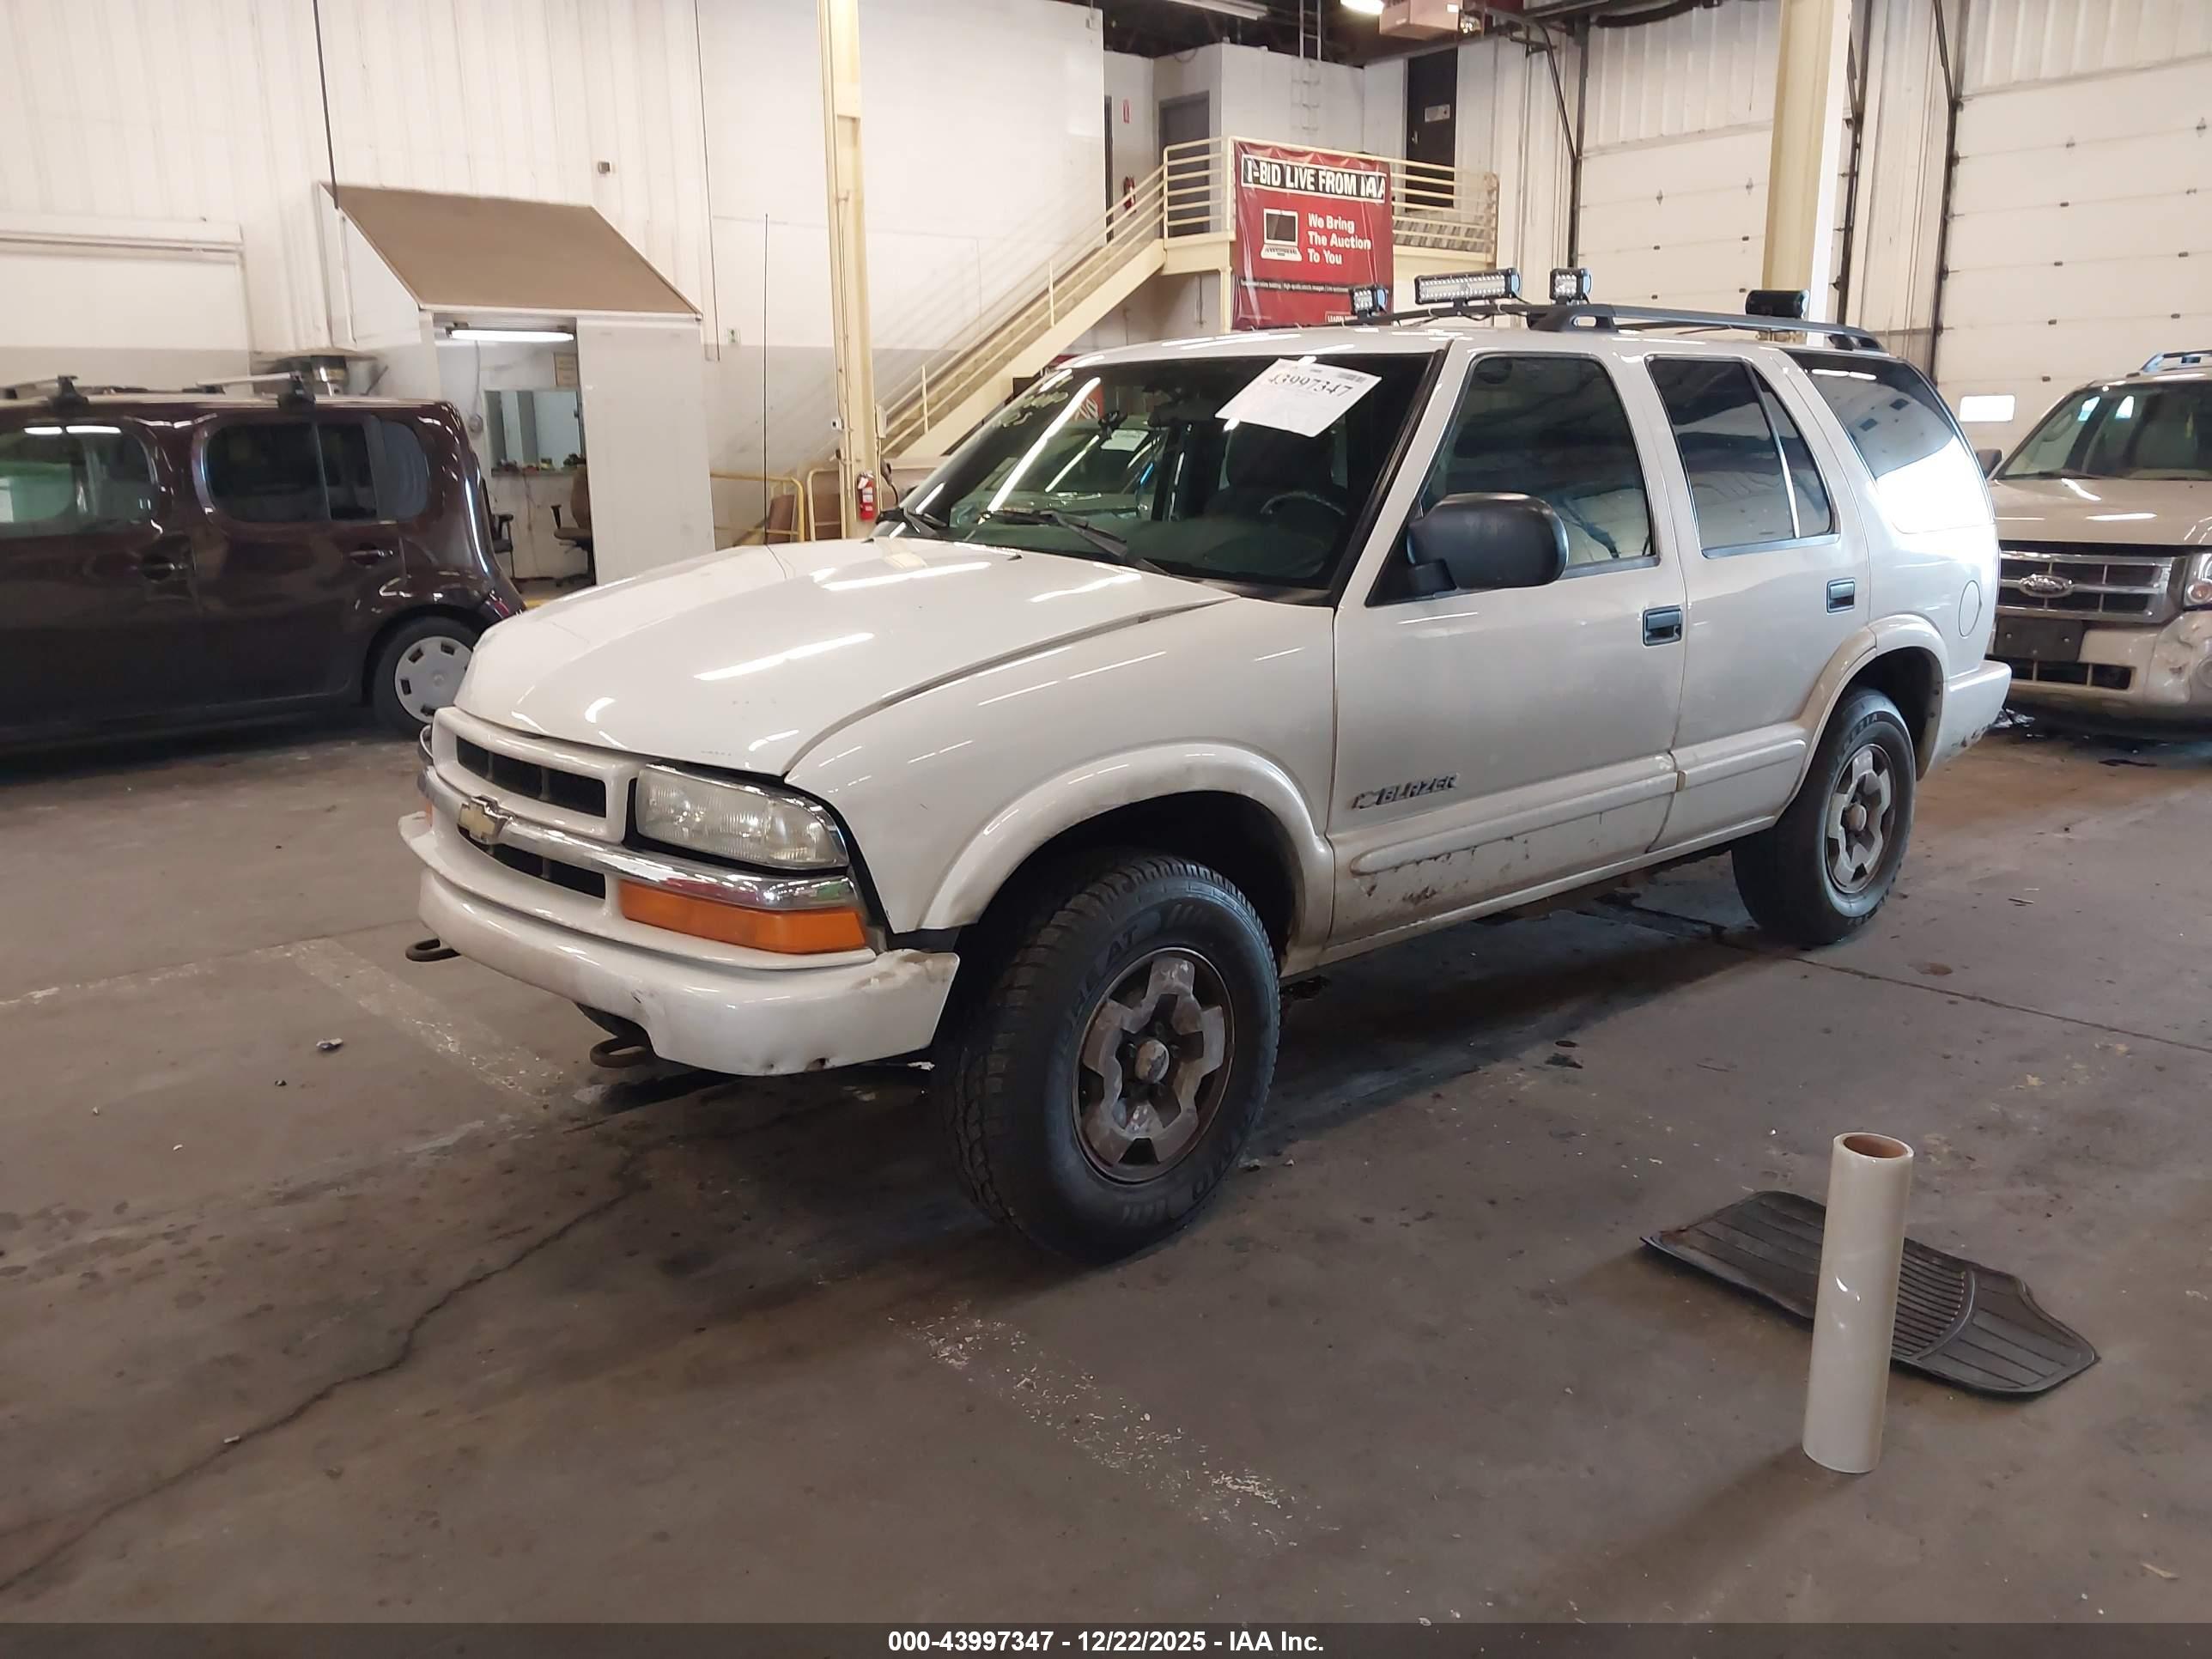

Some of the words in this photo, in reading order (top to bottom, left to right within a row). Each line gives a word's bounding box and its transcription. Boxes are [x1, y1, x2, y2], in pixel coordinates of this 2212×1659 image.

[1247, 160, 1281, 186] I-BID
[1285, 165, 1316, 191] LIVE
[1319, 170, 1357, 196] FROM
[1360, 174, 1385, 198] IAA
[1308, 212, 1324, 228] We
[1326, 215, 1355, 234] Bring
[1308, 230, 1328, 246] The
[1330, 233, 1371, 250] Auction
[1308, 247, 1320, 264] To
[1323, 249, 1342, 265] You
